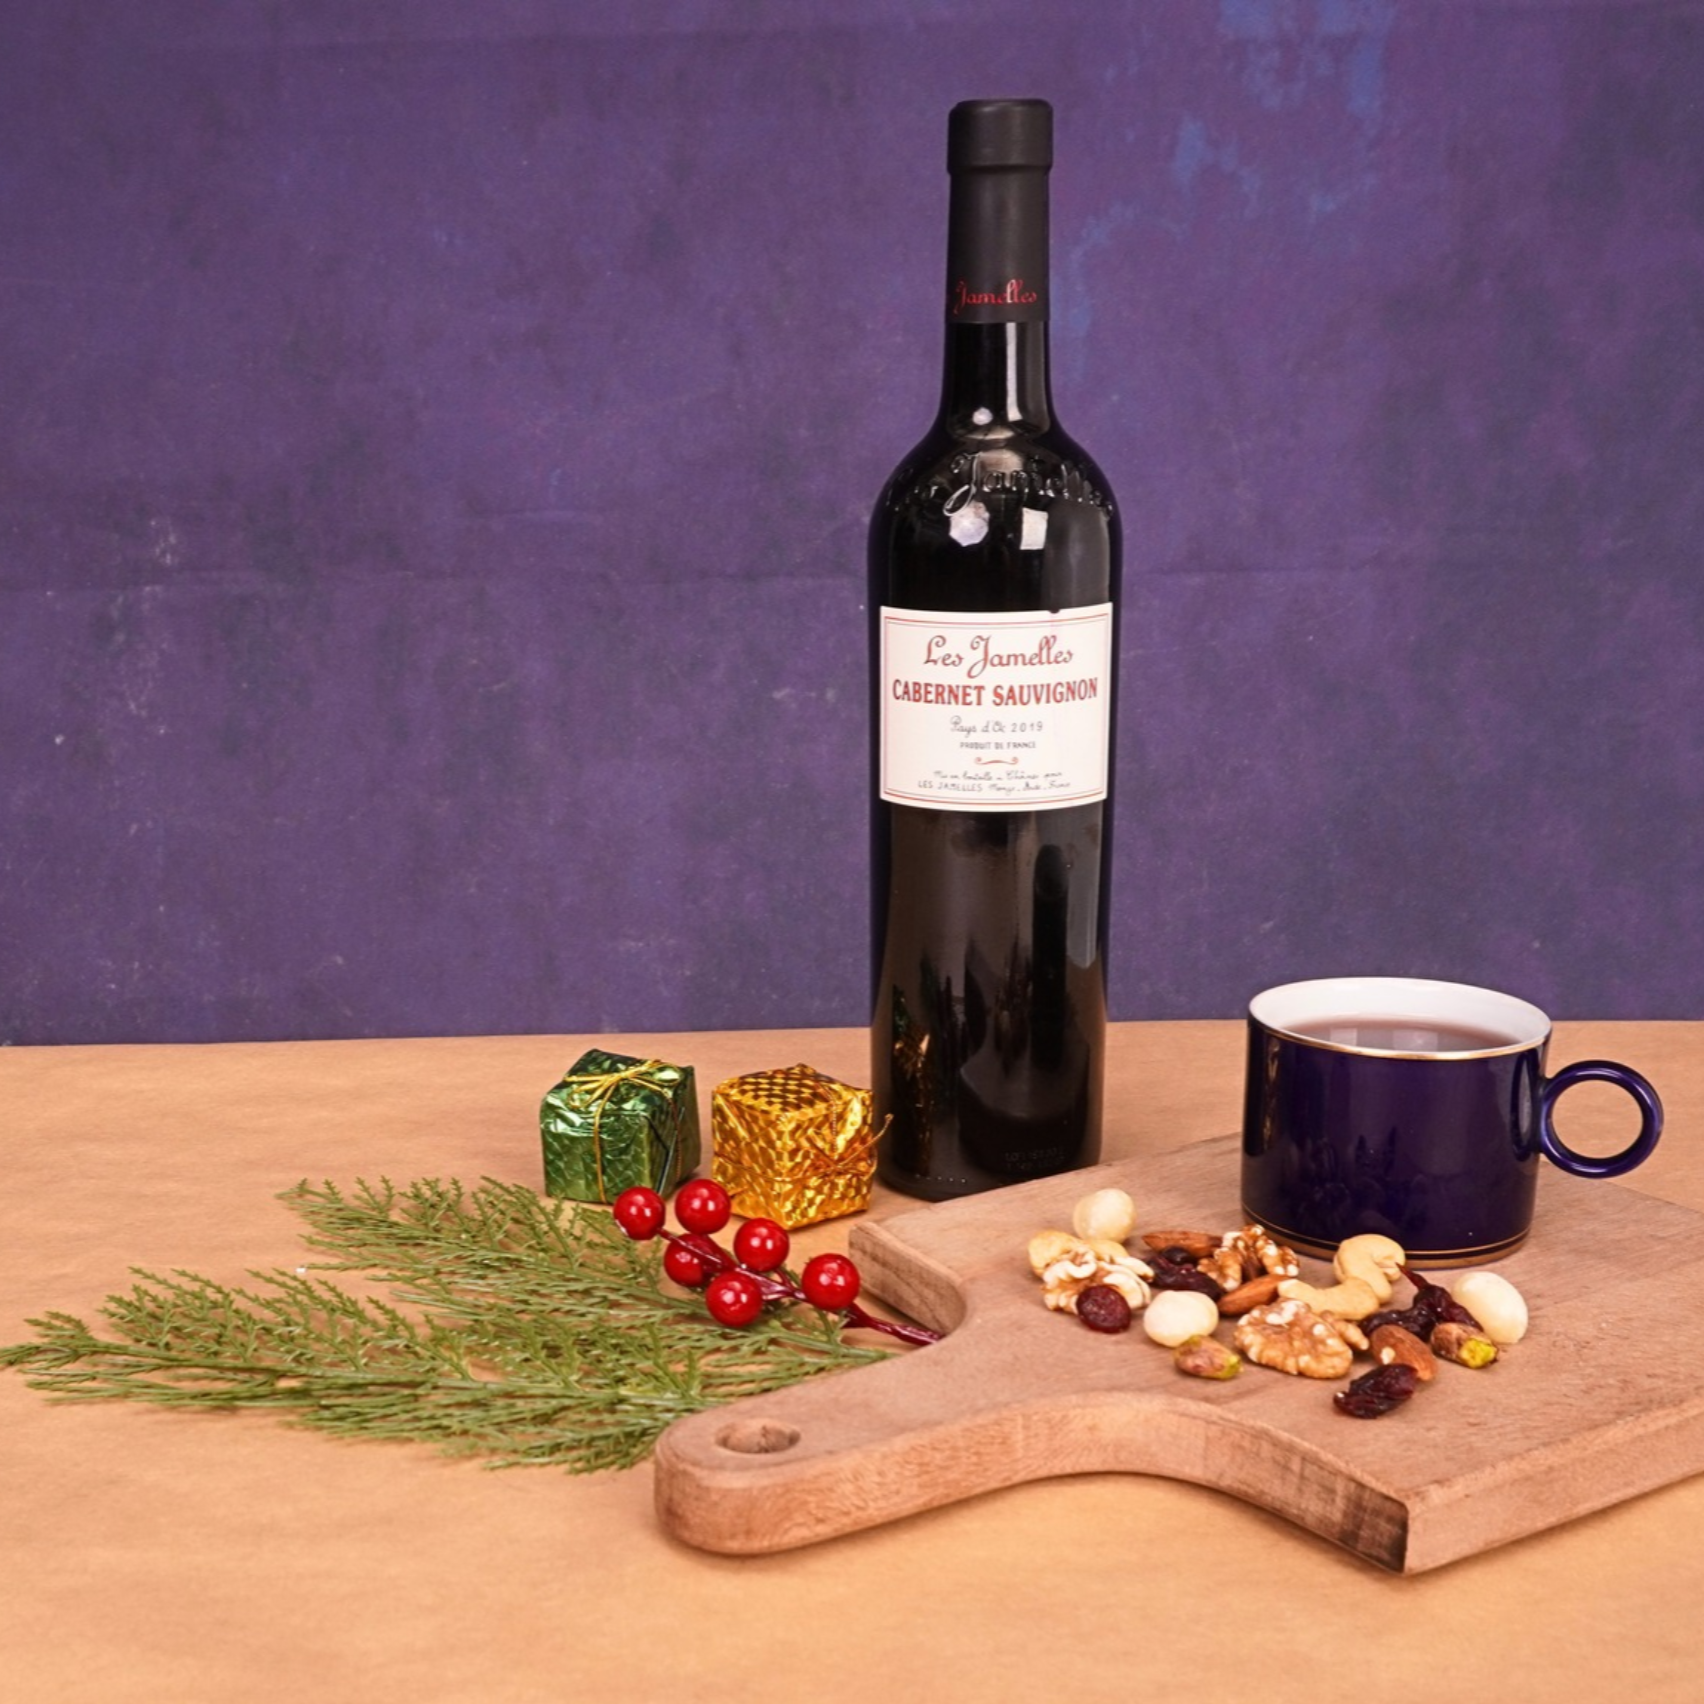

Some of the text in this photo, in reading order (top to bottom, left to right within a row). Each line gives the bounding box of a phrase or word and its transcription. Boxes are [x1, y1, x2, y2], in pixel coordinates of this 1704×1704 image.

[953, 277, 1038, 316] Jamelles
[923, 634, 1074, 679] Les Jamelles
[892, 677, 1098, 706] CABERNET SAUVIGNON
[949, 715, 977, 738] Pays
[1011, 720, 1044, 733] 2019
[959, 741, 1036, 750] PRODUIT DE FRANCE
[918, 780, 933, 789] LES
